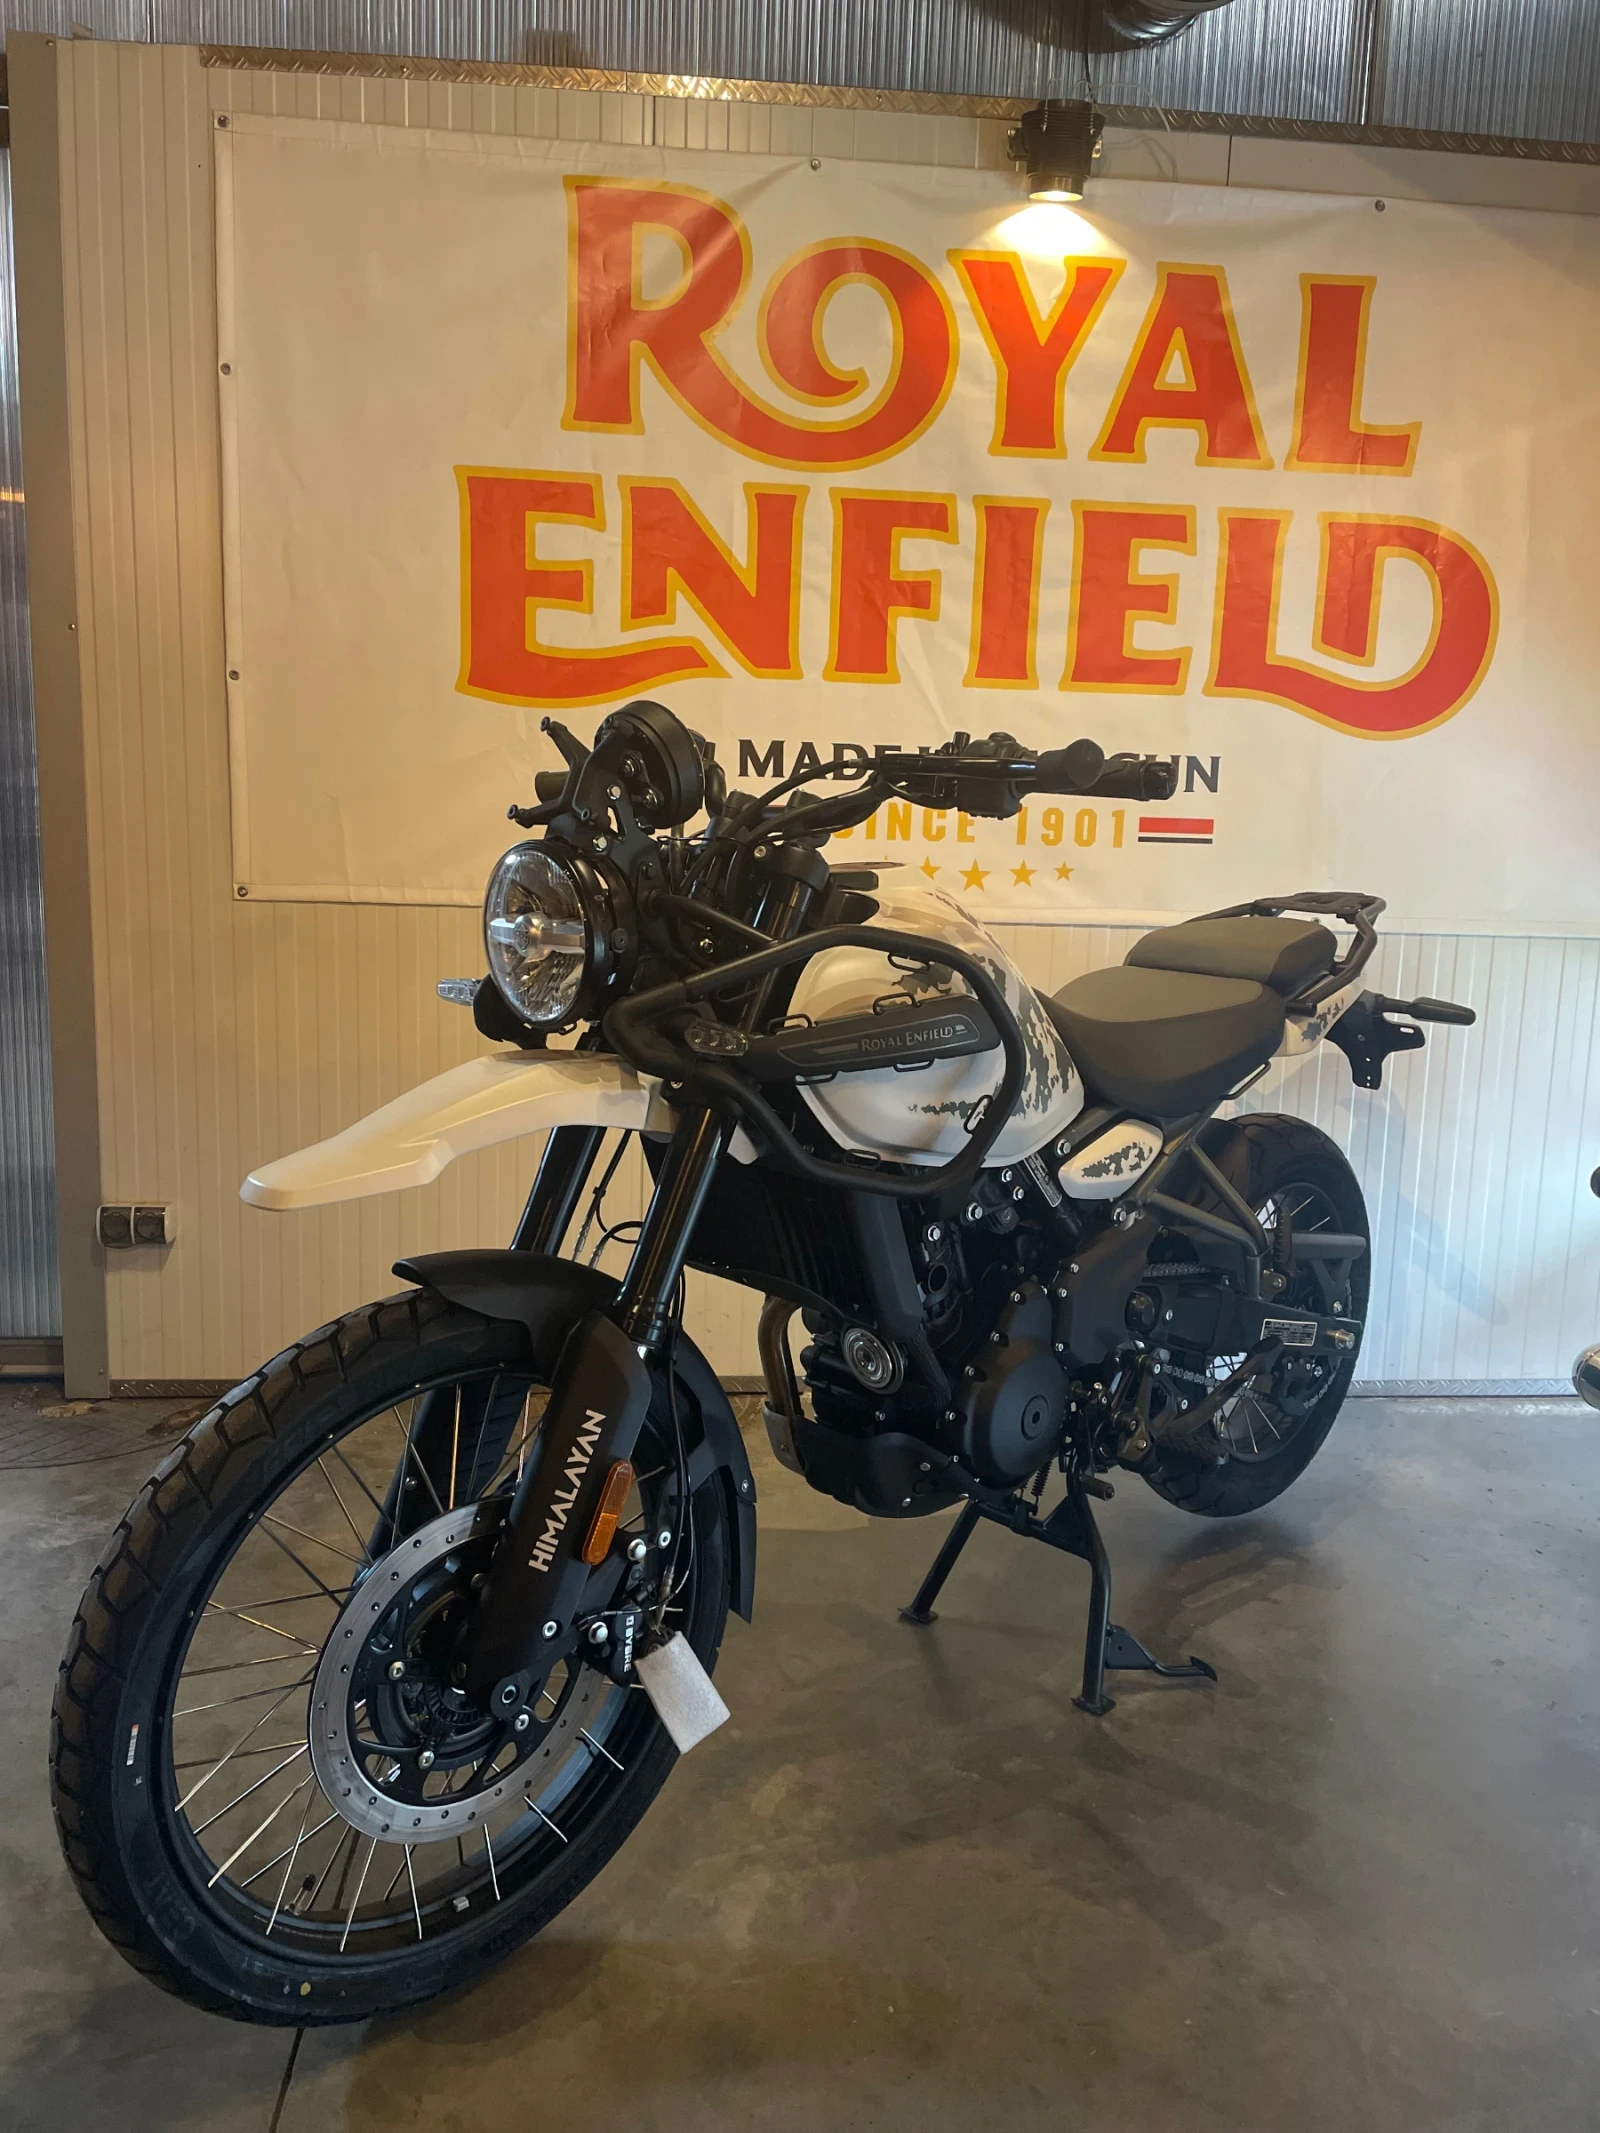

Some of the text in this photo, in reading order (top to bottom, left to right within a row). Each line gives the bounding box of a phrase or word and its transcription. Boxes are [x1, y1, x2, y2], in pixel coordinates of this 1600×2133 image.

[561, 174, 1422, 478] ROYAL
[453, 464, 1500, 740] ENFIELD
[738, 739, 902, 781] MAD
[1016, 806, 1126, 848] 1901
[861, 1026, 954, 1052] ROYAL ENFIELD
[528, 1409, 607, 1572] HIMALAYAN
